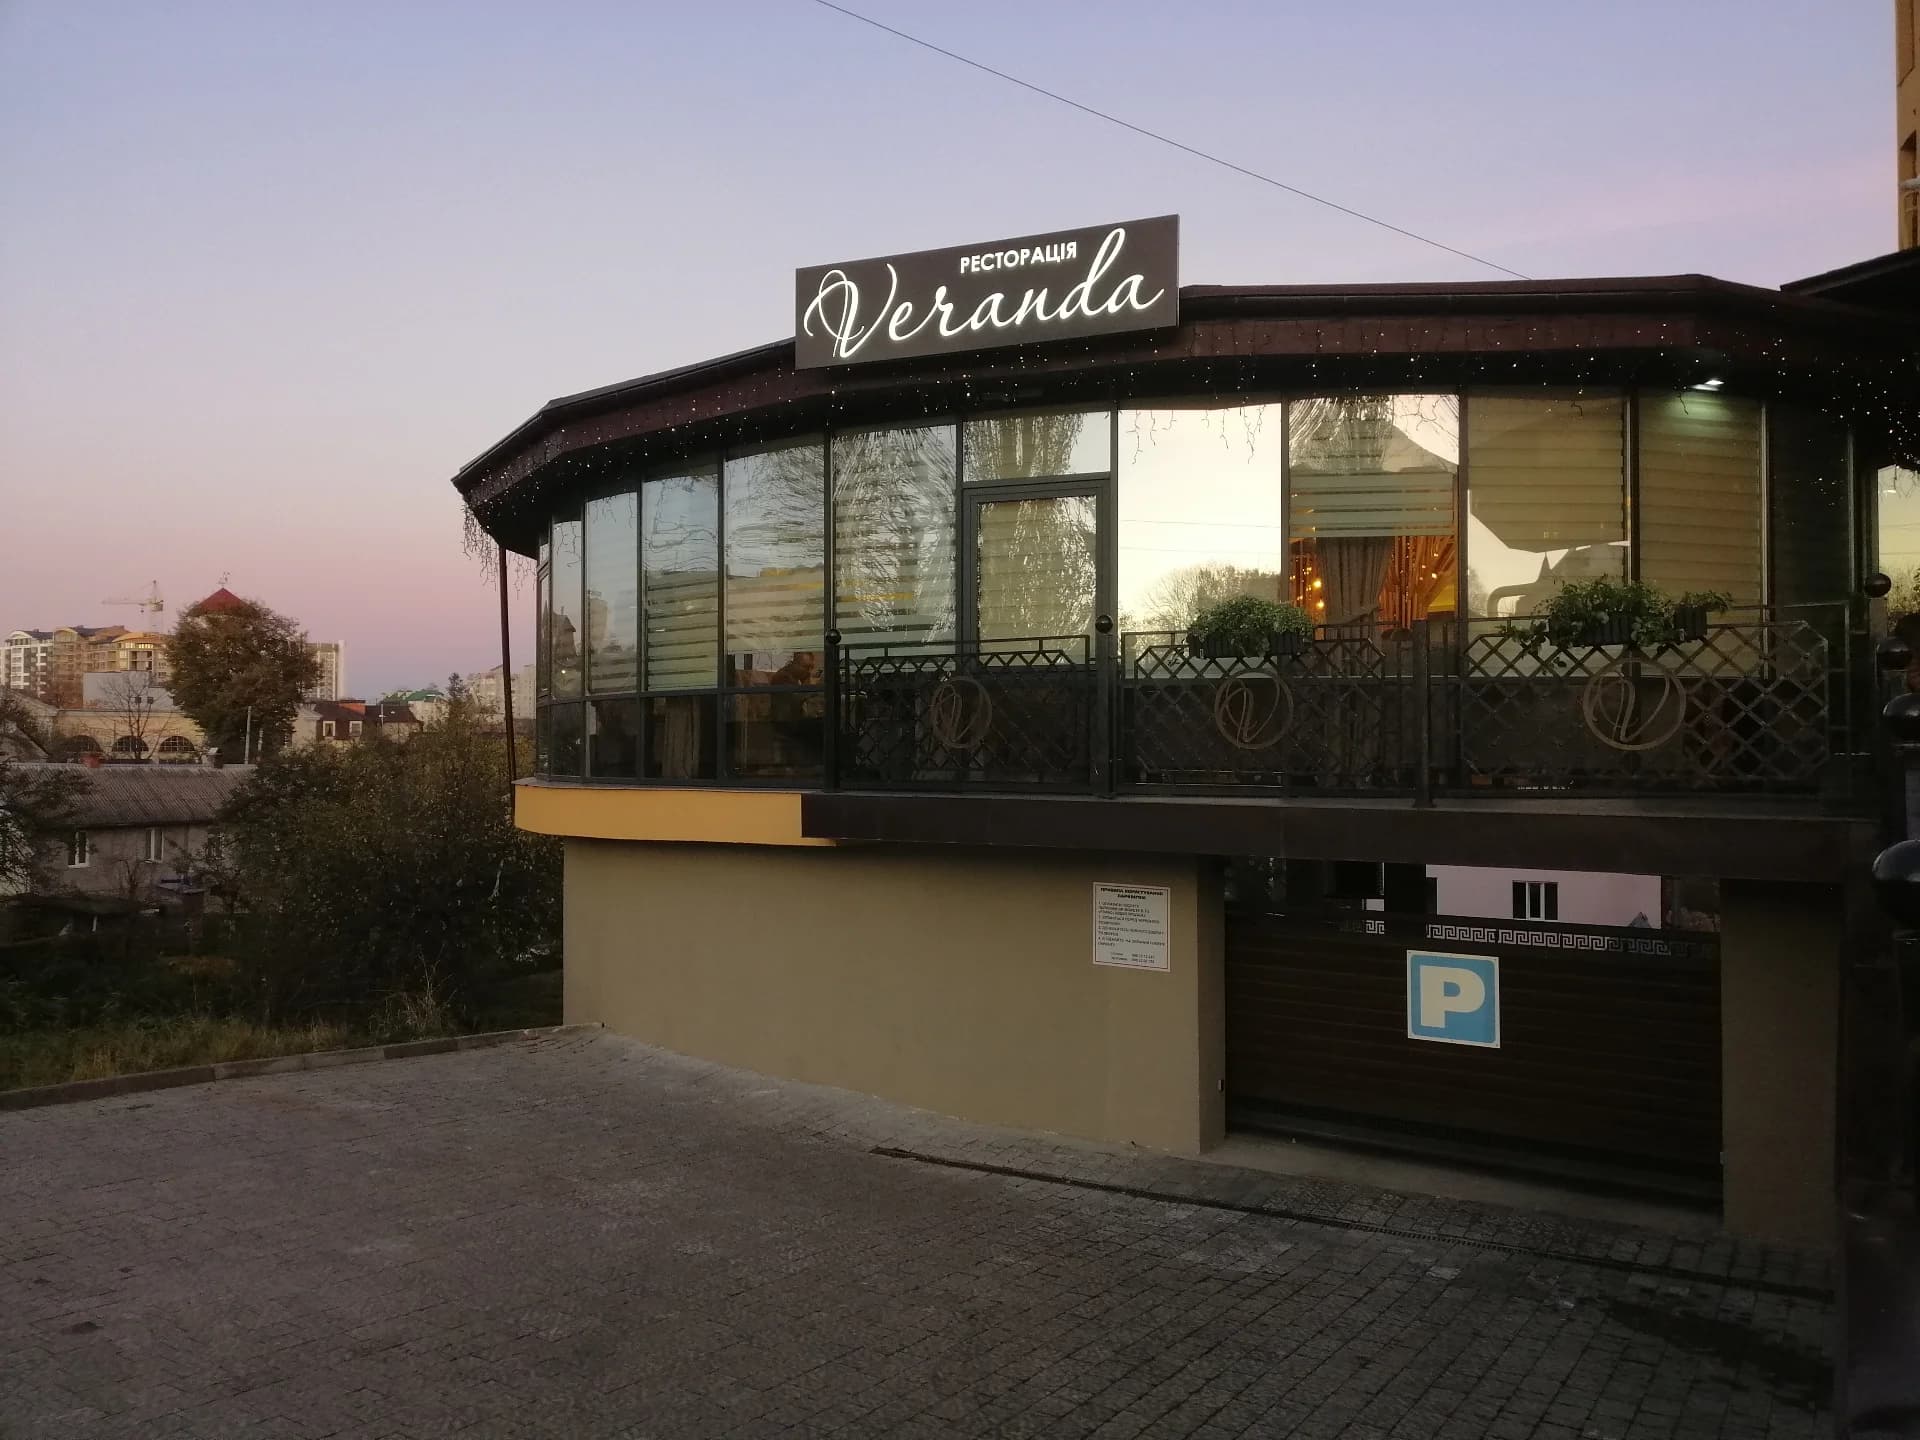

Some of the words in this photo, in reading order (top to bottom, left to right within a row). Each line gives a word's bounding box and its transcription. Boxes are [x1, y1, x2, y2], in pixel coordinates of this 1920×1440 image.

[960, 241, 1077, 273] РЕСТОРАЦІЯ
[803, 227, 1165, 358] Veranda
[1420, 965, 1486, 1029] P
